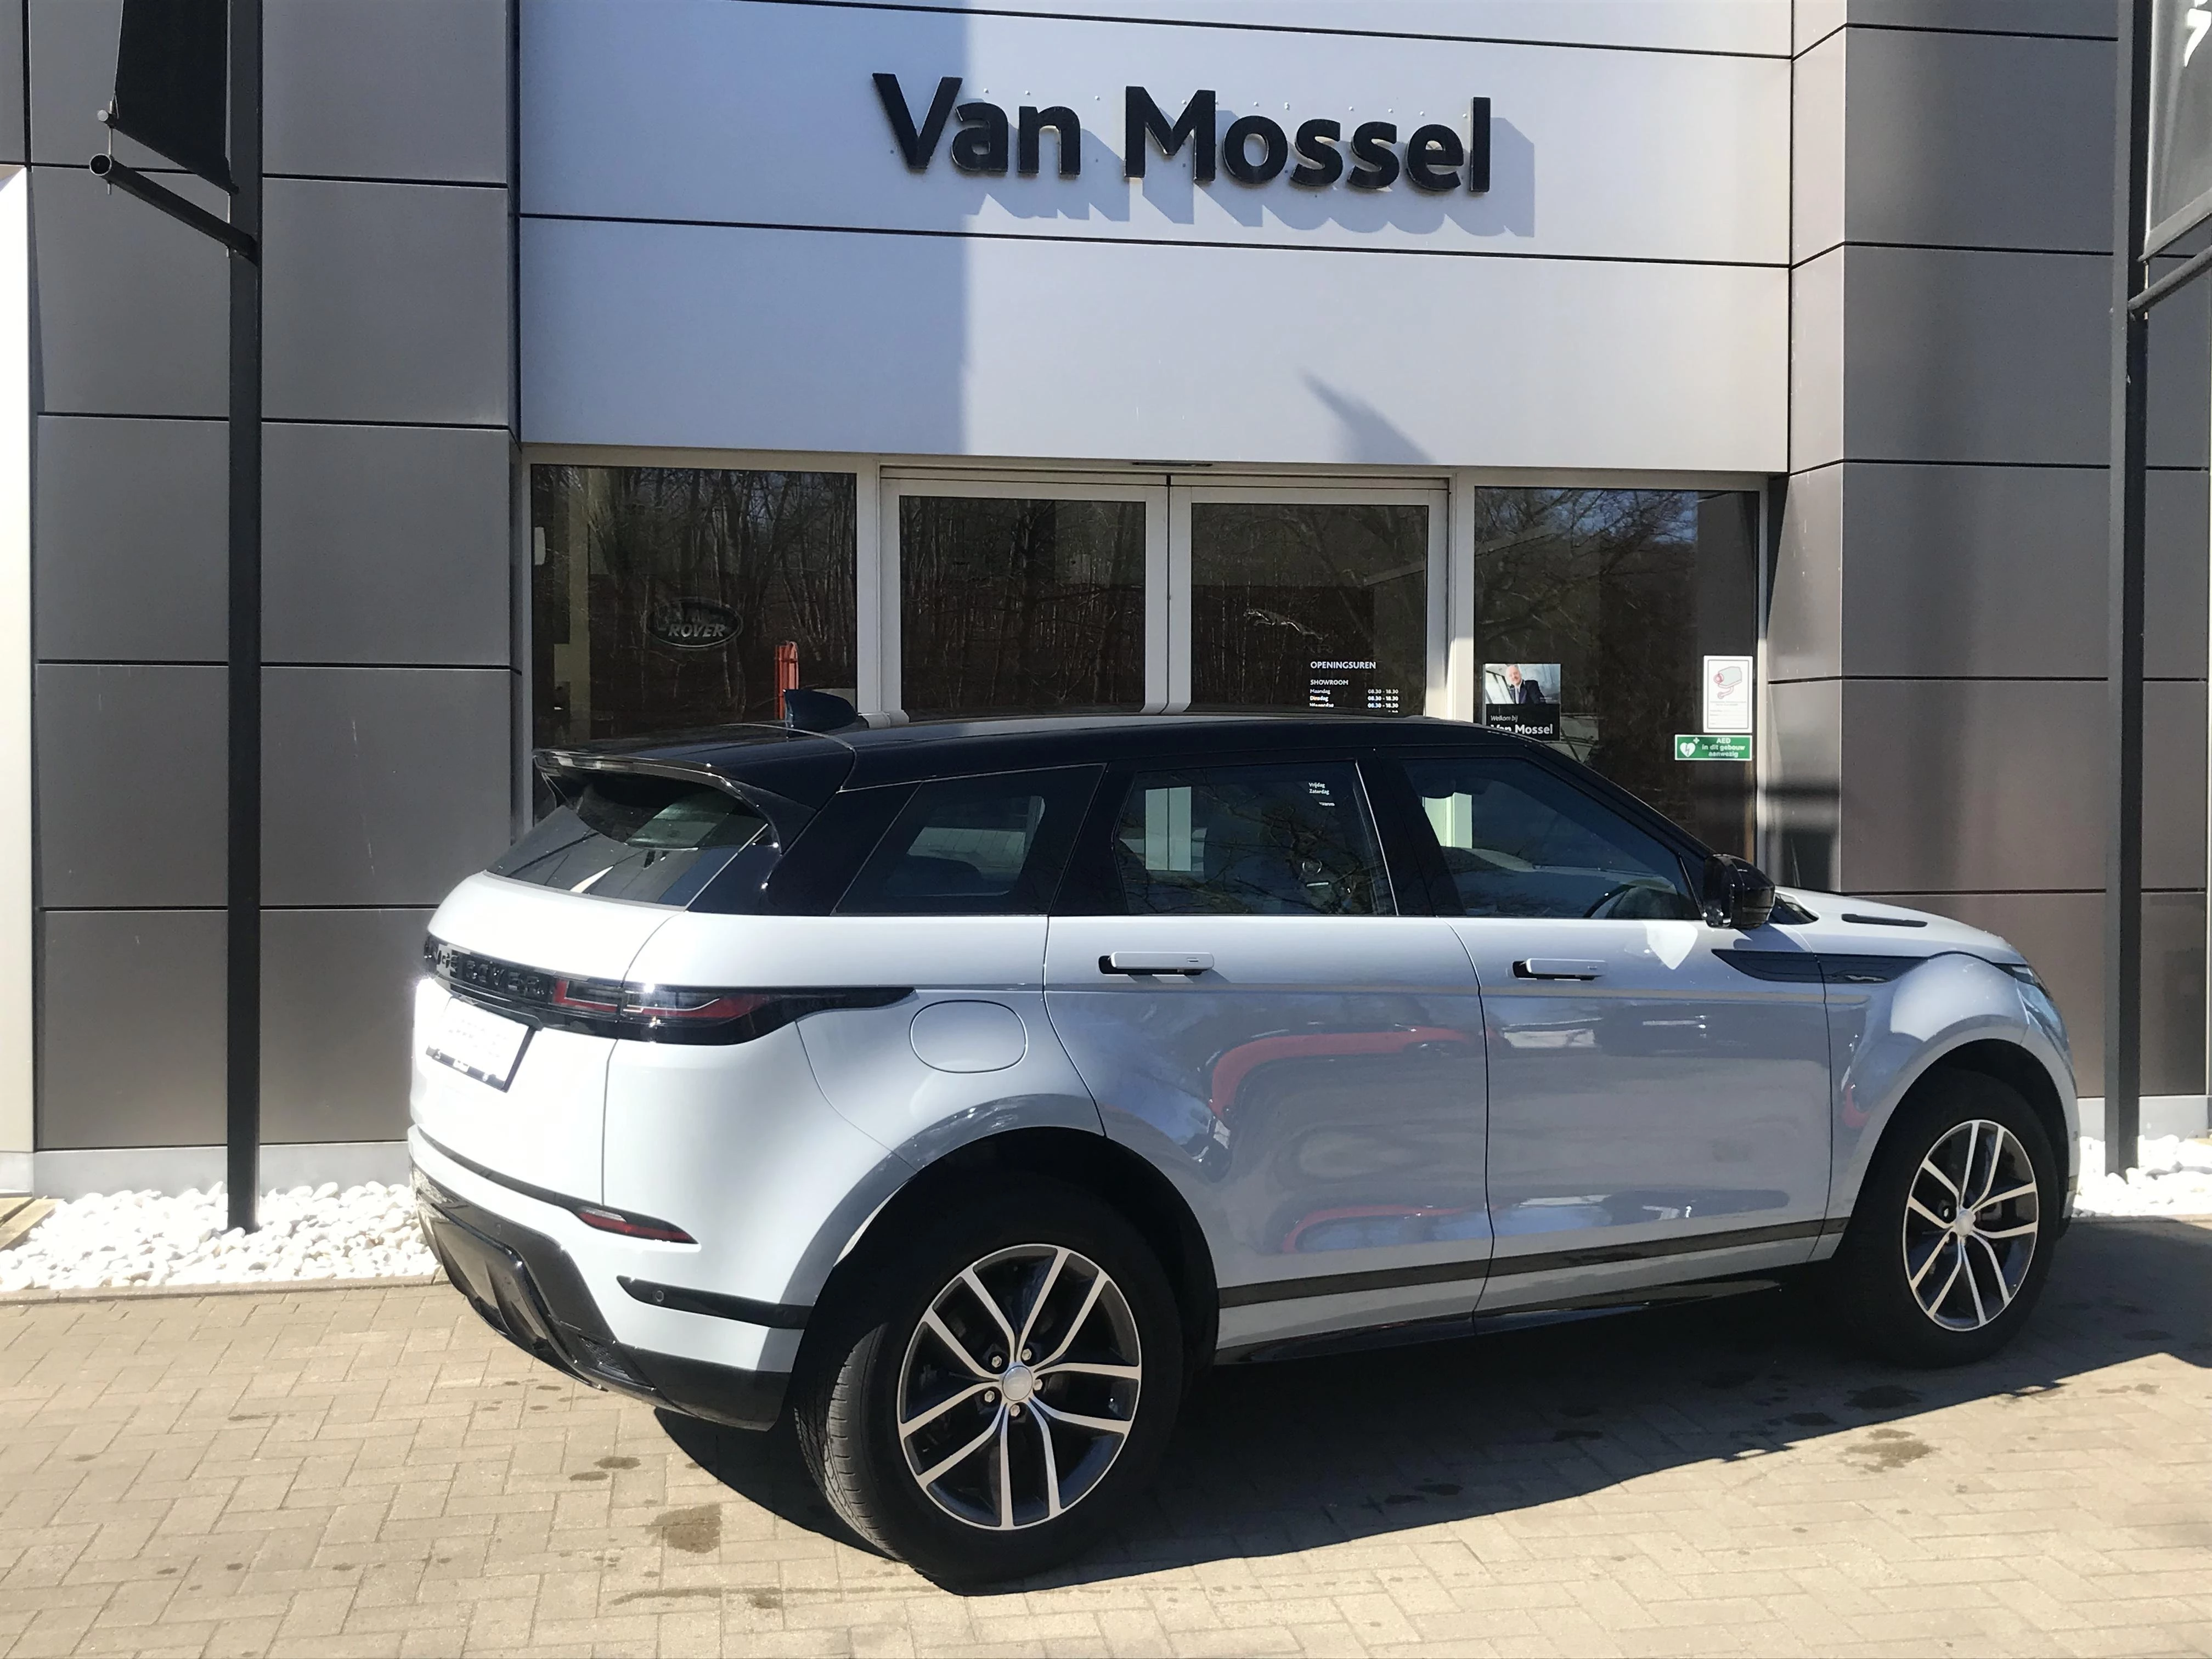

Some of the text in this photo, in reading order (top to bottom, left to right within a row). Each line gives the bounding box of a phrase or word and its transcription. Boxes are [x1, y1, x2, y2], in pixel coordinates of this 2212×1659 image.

[872, 71, 1491, 194] Van Mossel
[667, 623, 726, 637] ROVER
[1310, 661, 1377, 669] OPENINGSUREN
[1515, 723, 1553, 735] Mossel
